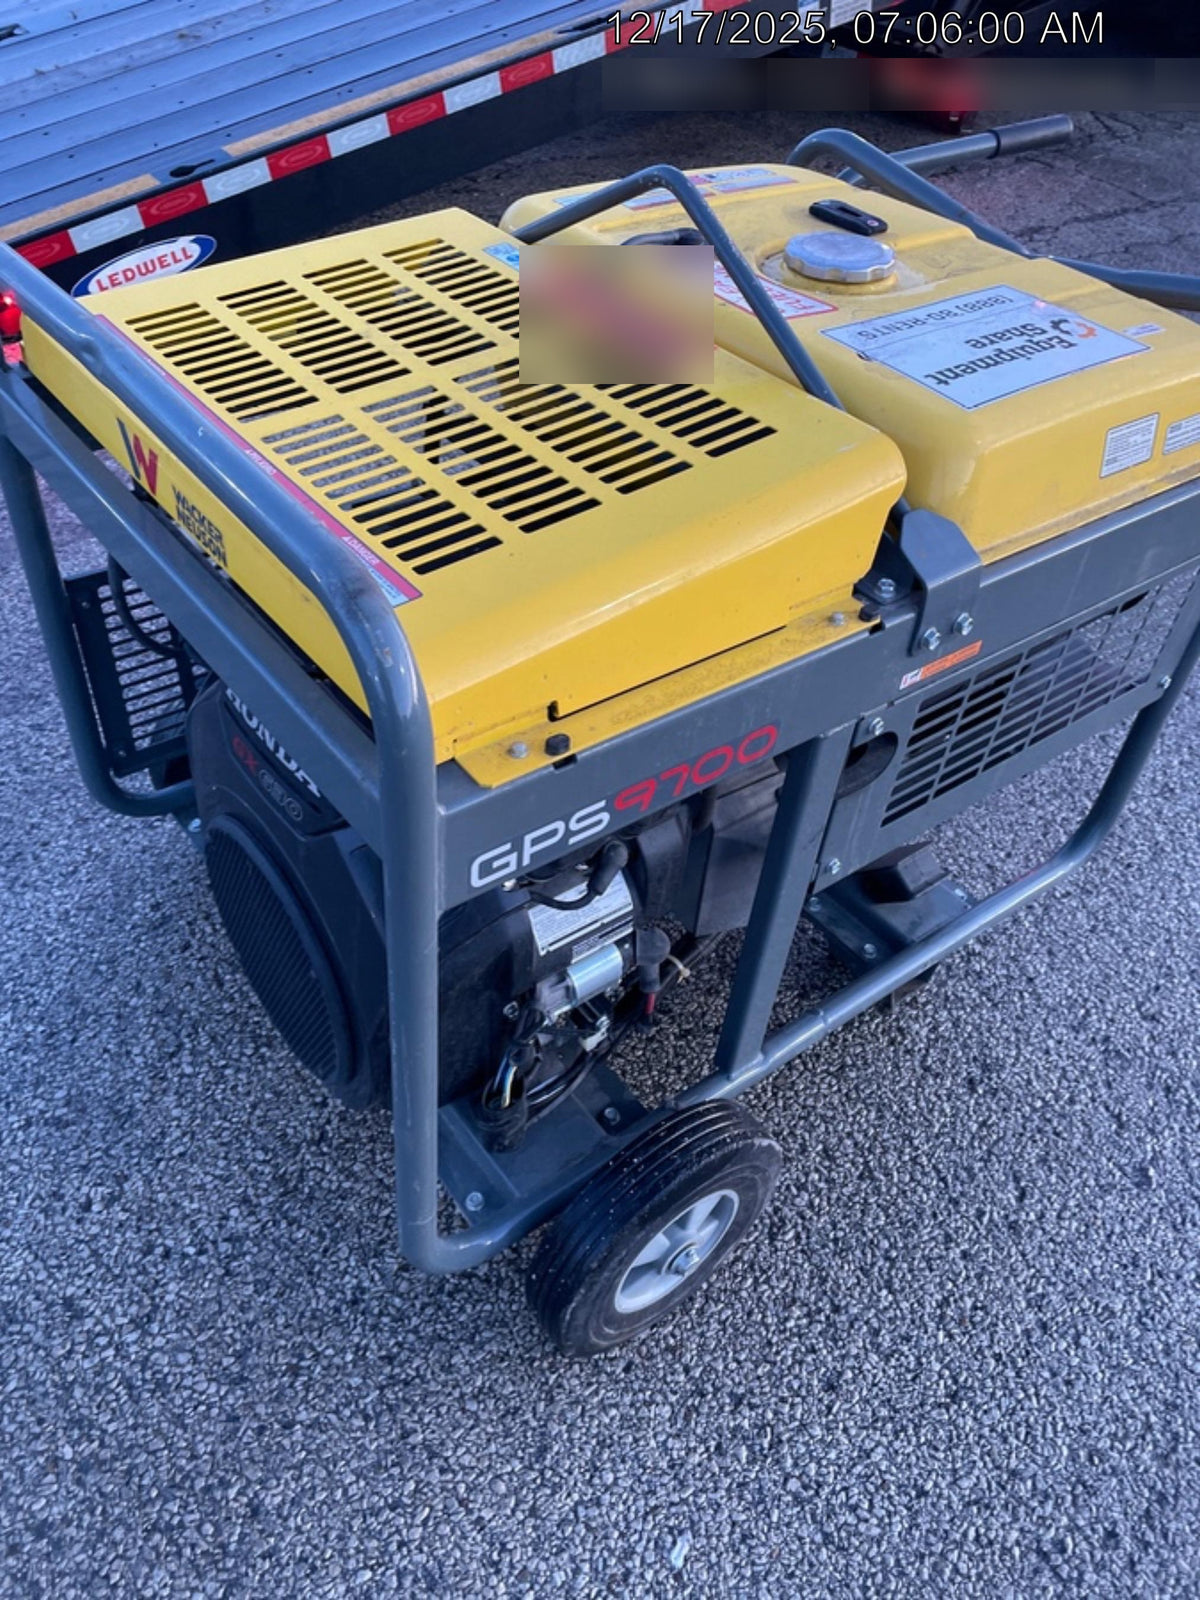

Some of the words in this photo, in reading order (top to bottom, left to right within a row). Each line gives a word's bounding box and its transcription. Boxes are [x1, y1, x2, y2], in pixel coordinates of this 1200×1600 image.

[96, 246, 194, 292] LEDWELL
[923, 335, 1078, 386] Equipment
[964, 323, 1048, 349] Share
[171, 484, 223, 545] WACKER
[176, 503, 228, 568] NEUSON
